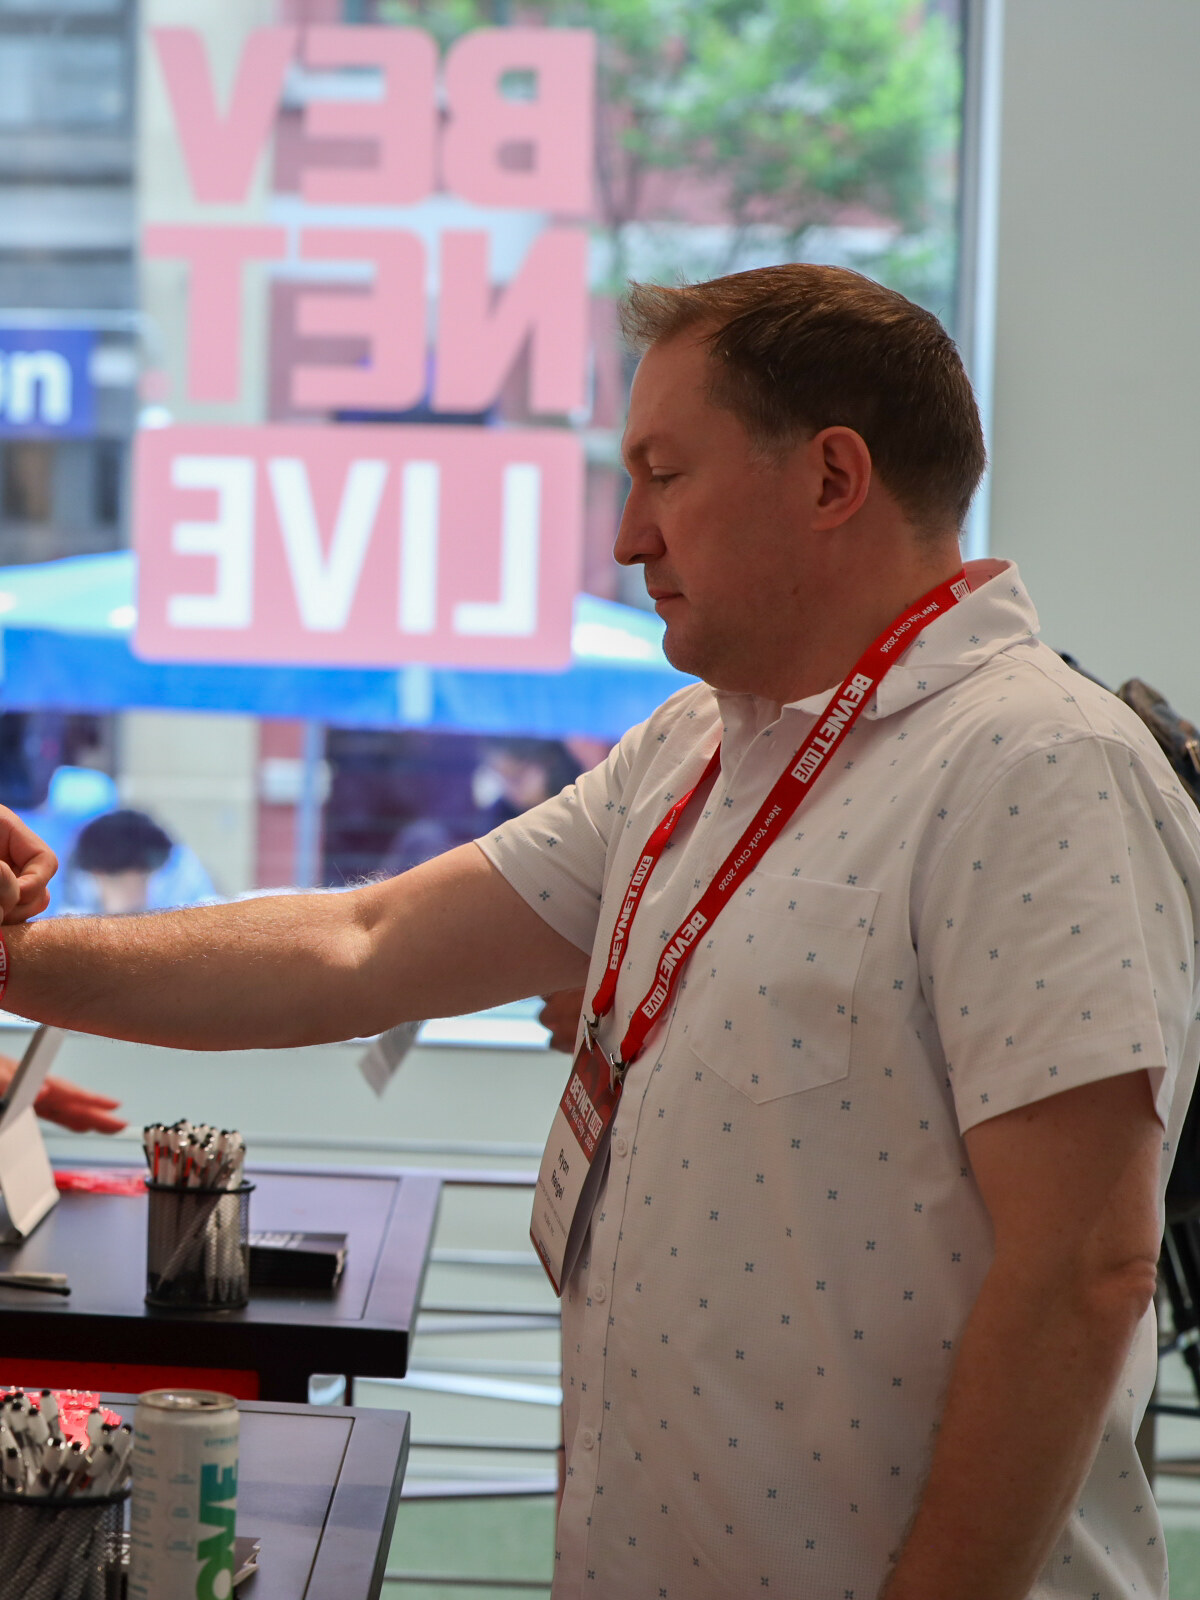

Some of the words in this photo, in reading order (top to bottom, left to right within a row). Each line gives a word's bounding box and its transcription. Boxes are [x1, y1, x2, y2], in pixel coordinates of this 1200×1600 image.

[893, 622, 912, 637] City
[880, 636, 899, 653] 2026
[764, 804, 782, 827] New
[749, 827, 768, 849] York
[734, 849, 752, 869] City
[718, 868, 737, 891] 2026
[557, 1148, 570, 1176] Ryan
